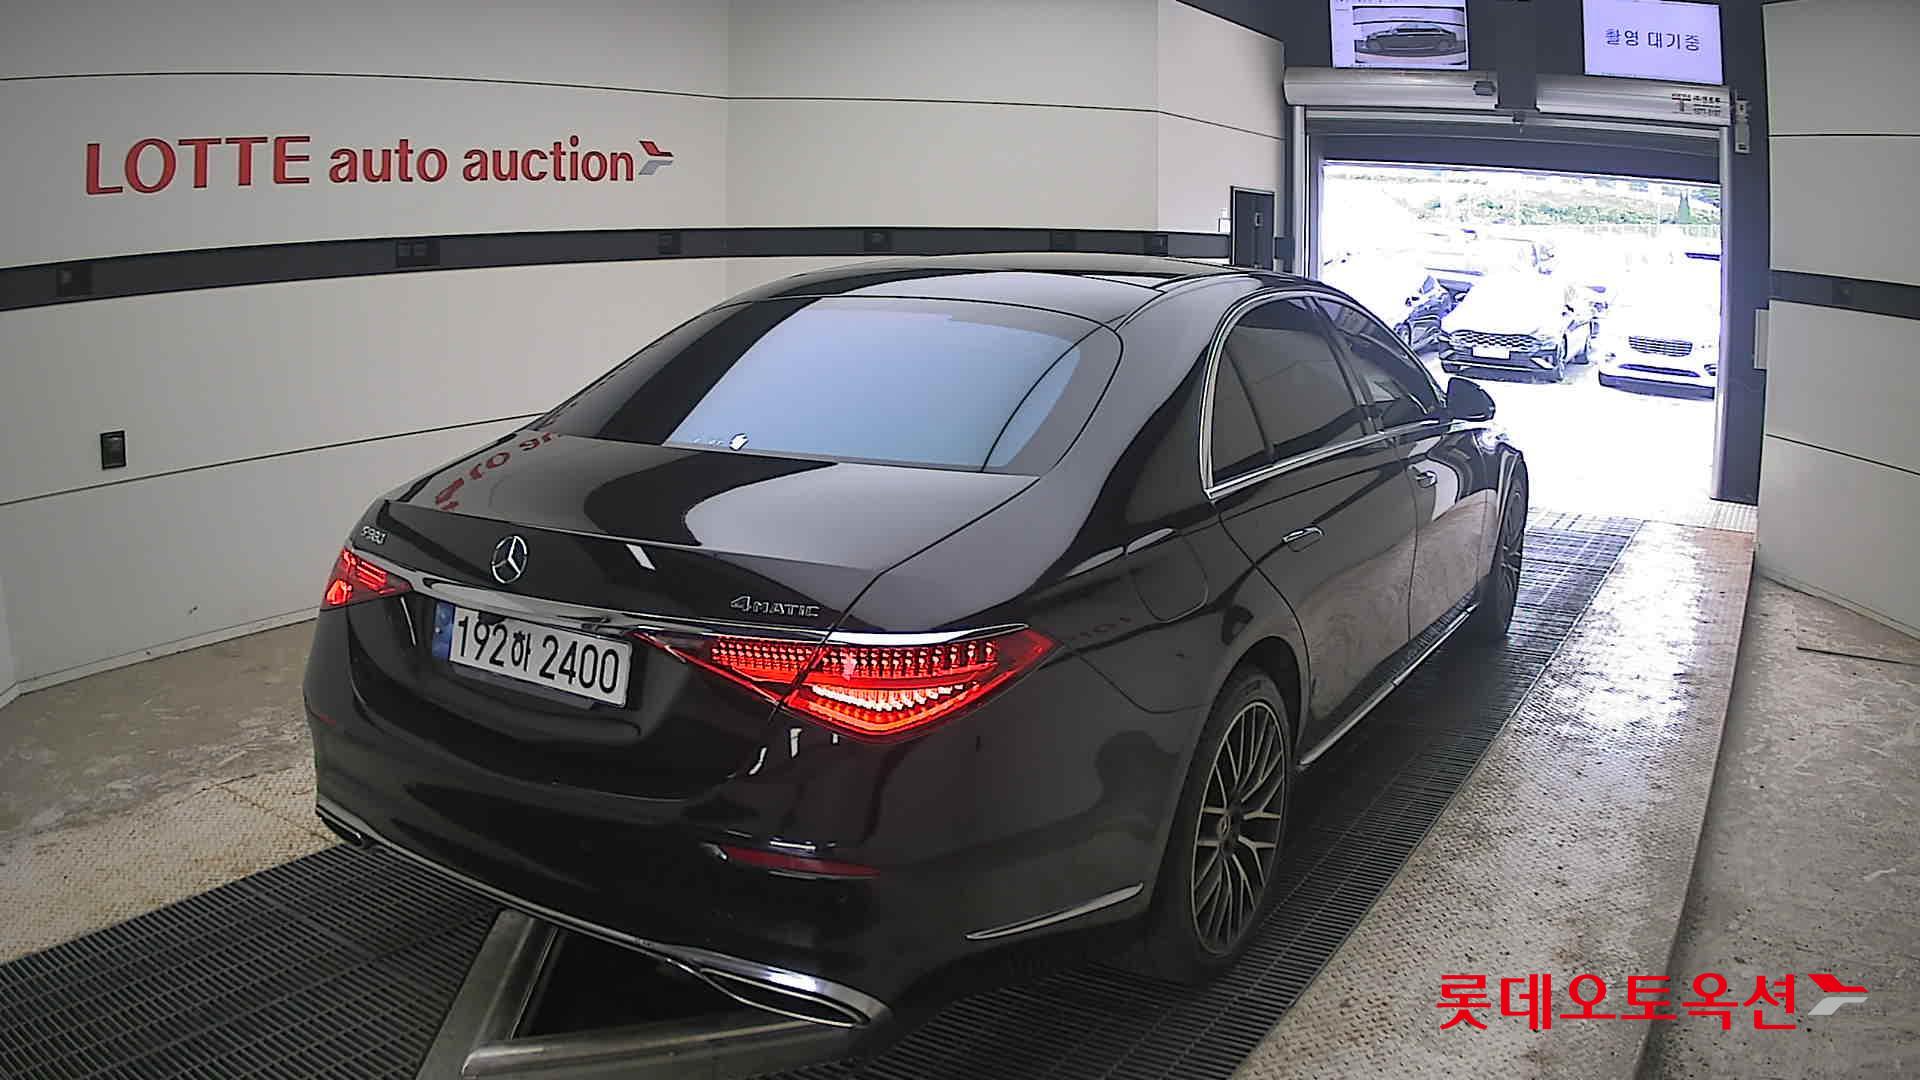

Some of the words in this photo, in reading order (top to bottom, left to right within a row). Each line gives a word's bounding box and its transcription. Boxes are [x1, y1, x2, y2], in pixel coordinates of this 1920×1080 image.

[1647, 31, 1700, 52] 대기중
[85, 136, 311, 196] LOTTE
[328, 139, 449, 183] auto
[462, 135, 636, 182] auction
[730, 595, 820, 617] 4MATIC
[458, 615, 532, 672] 192하
[539, 634, 620, 694] 2400
